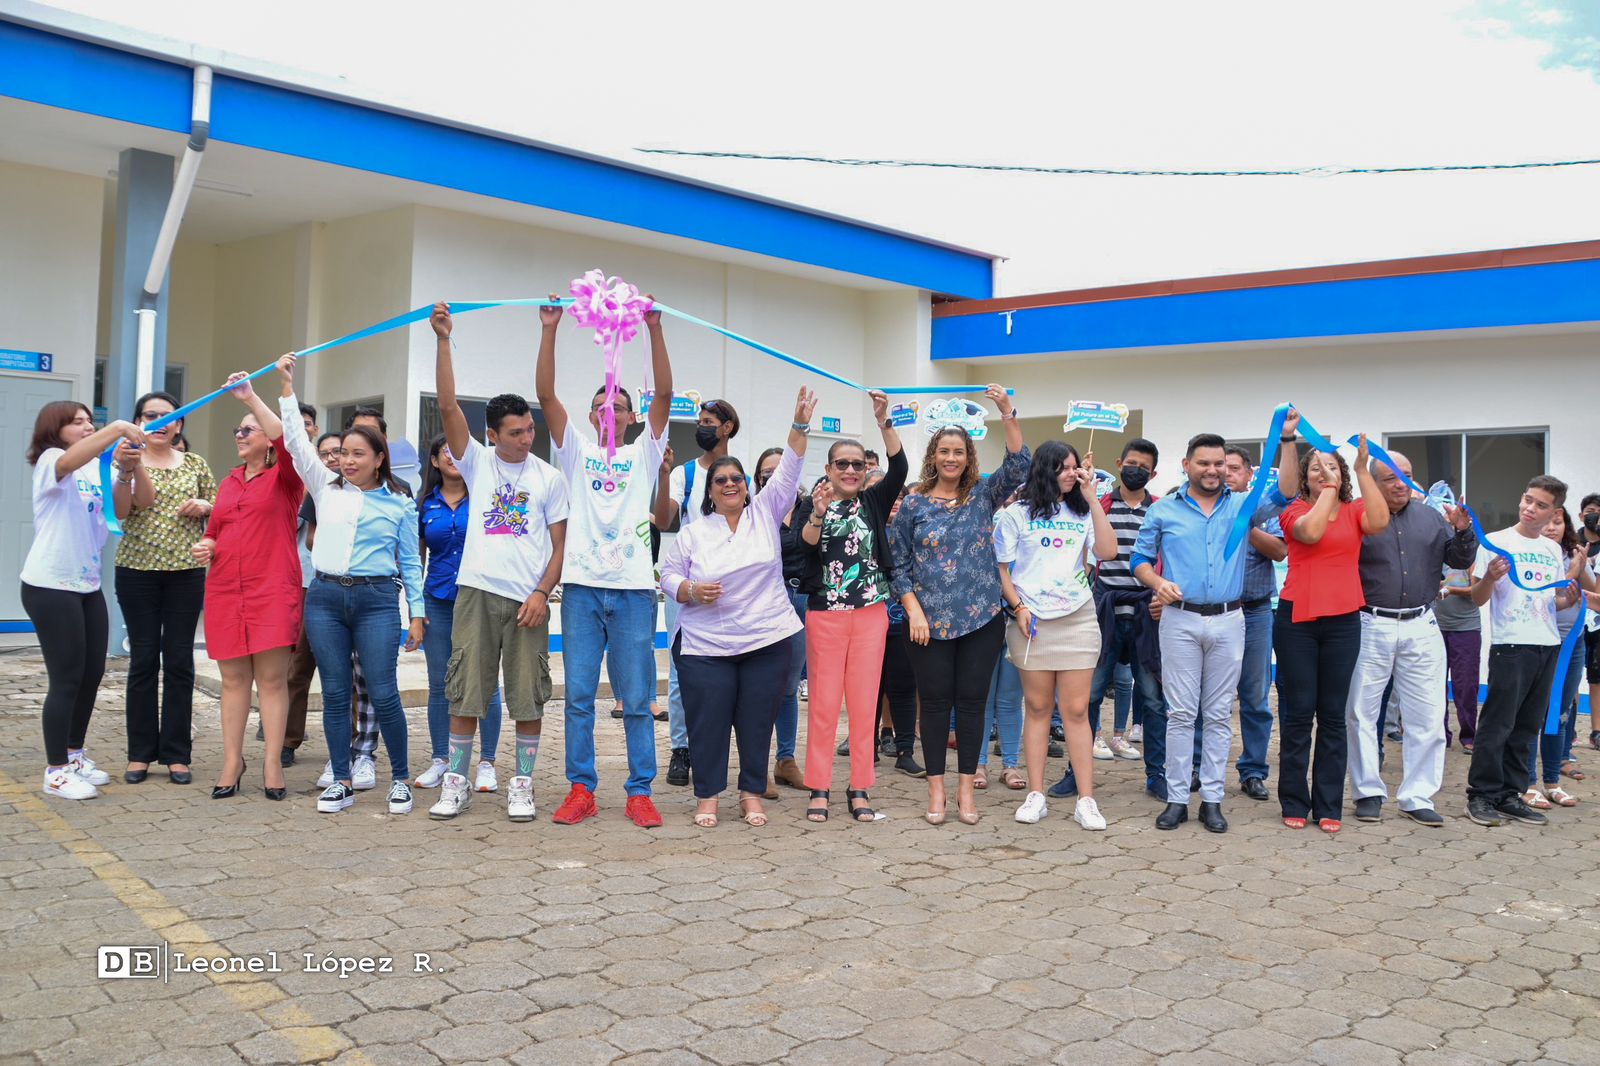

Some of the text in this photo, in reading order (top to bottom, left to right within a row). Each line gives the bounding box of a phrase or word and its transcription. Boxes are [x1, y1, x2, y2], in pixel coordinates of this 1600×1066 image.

[41, 355, 50, 370] 3
[835, 420, 840, 431] 9
[1028, 520, 1084, 534] INATEC
